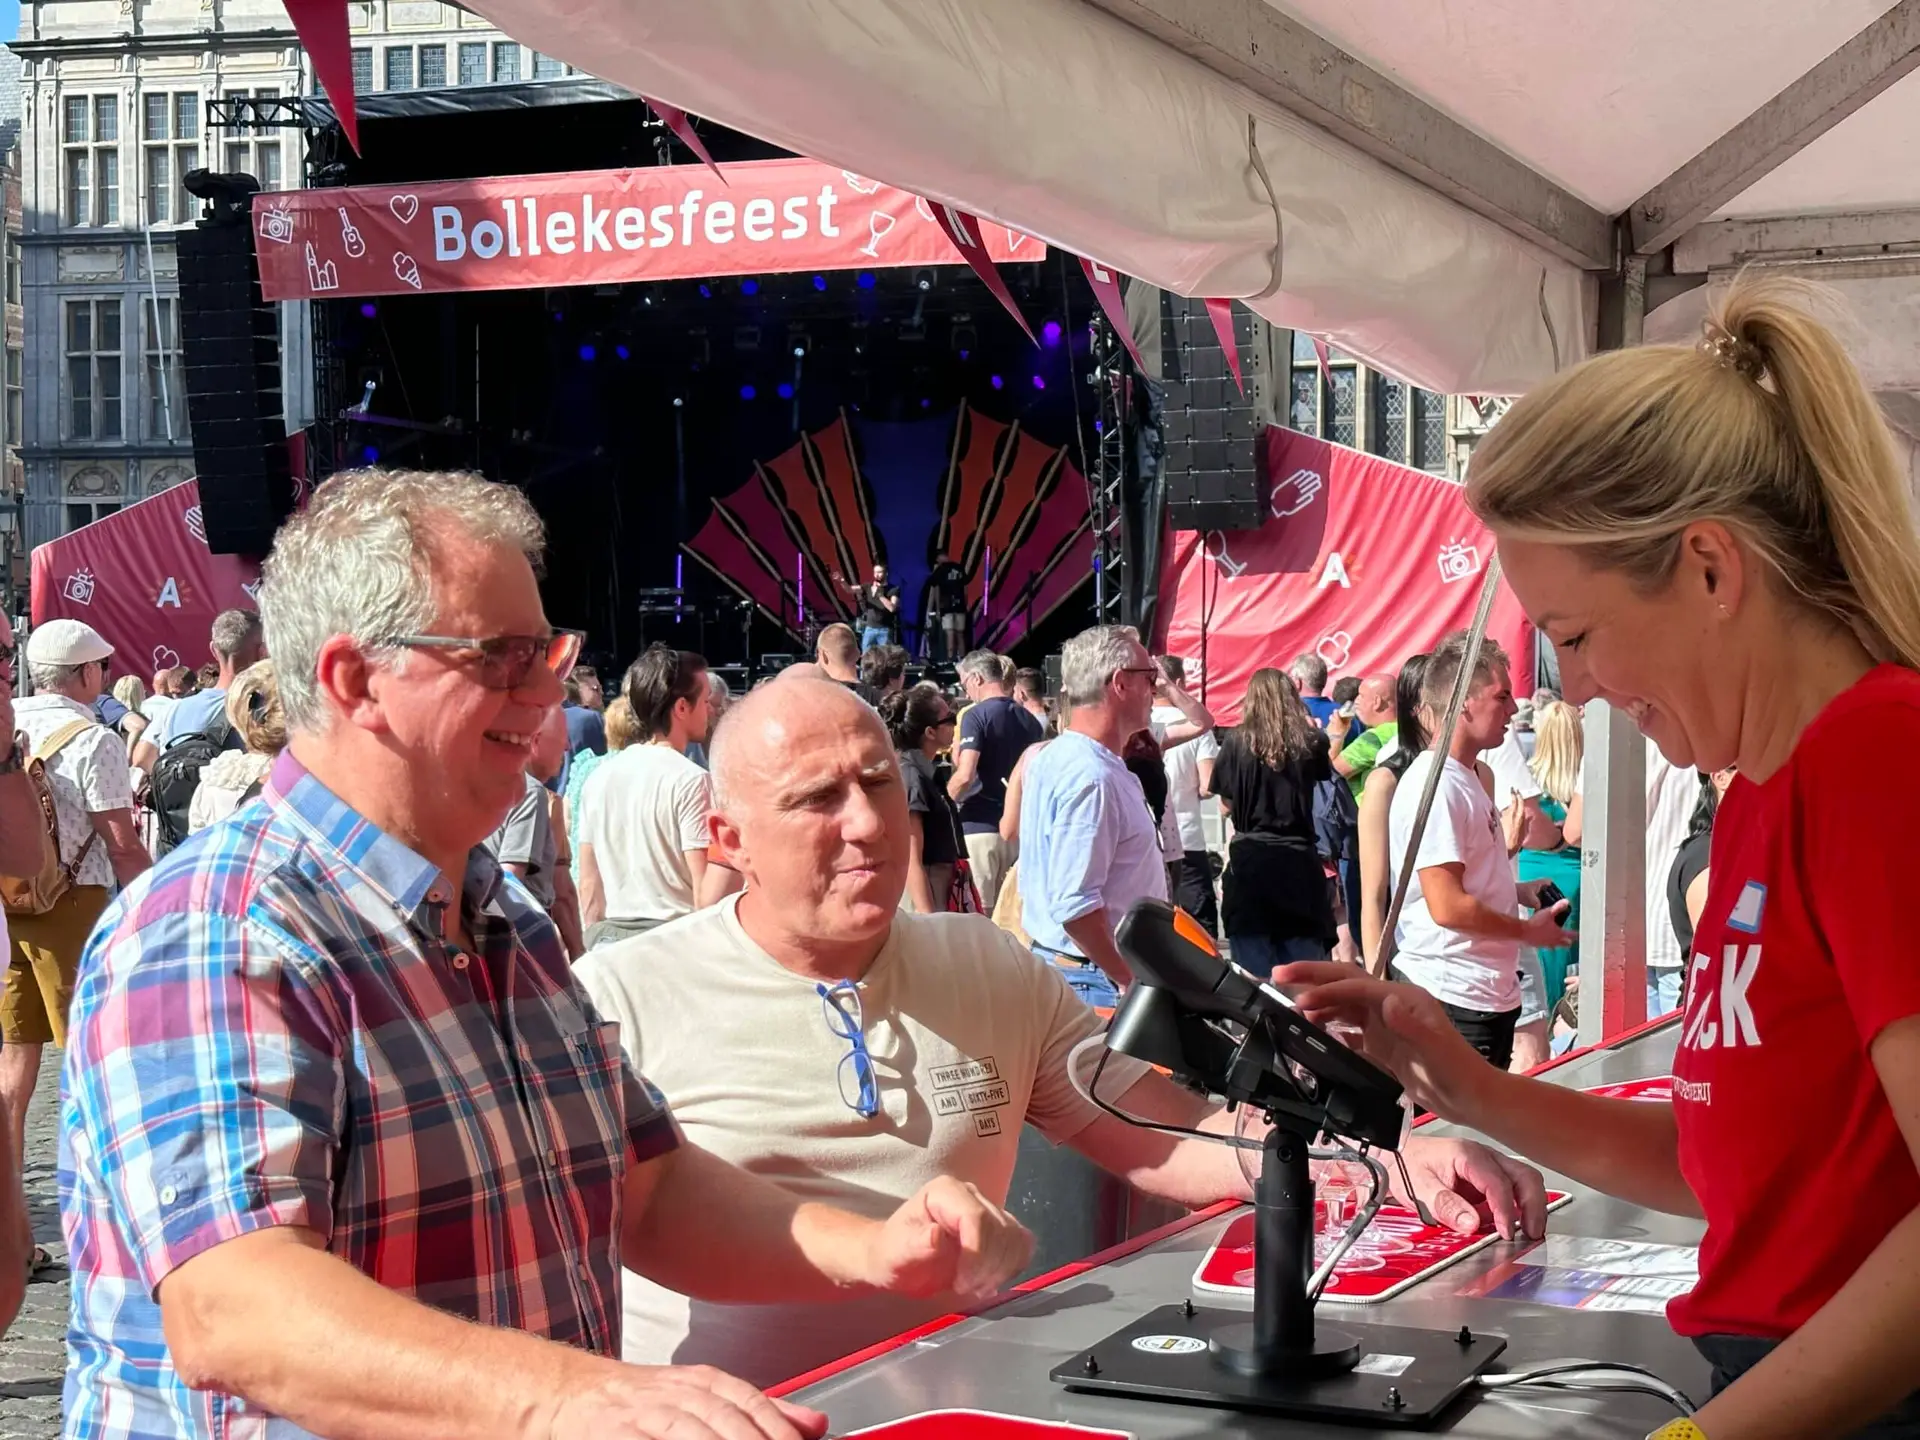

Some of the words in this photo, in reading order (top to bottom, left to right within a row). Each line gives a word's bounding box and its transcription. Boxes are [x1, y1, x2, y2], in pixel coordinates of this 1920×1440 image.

[431, 184, 840, 262] Bollekesfeest
[1317, 551, 1352, 589] A
[155, 576, 182, 608] A
[935, 1068, 961, 1083] THREE
[960, 1063, 993, 1080] HUNDRED
[940, 1095, 958, 1109] AND
[968, 1087, 1005, 1104] SIXTY-FIVE
[978, 1117, 996, 1130] DAYS
